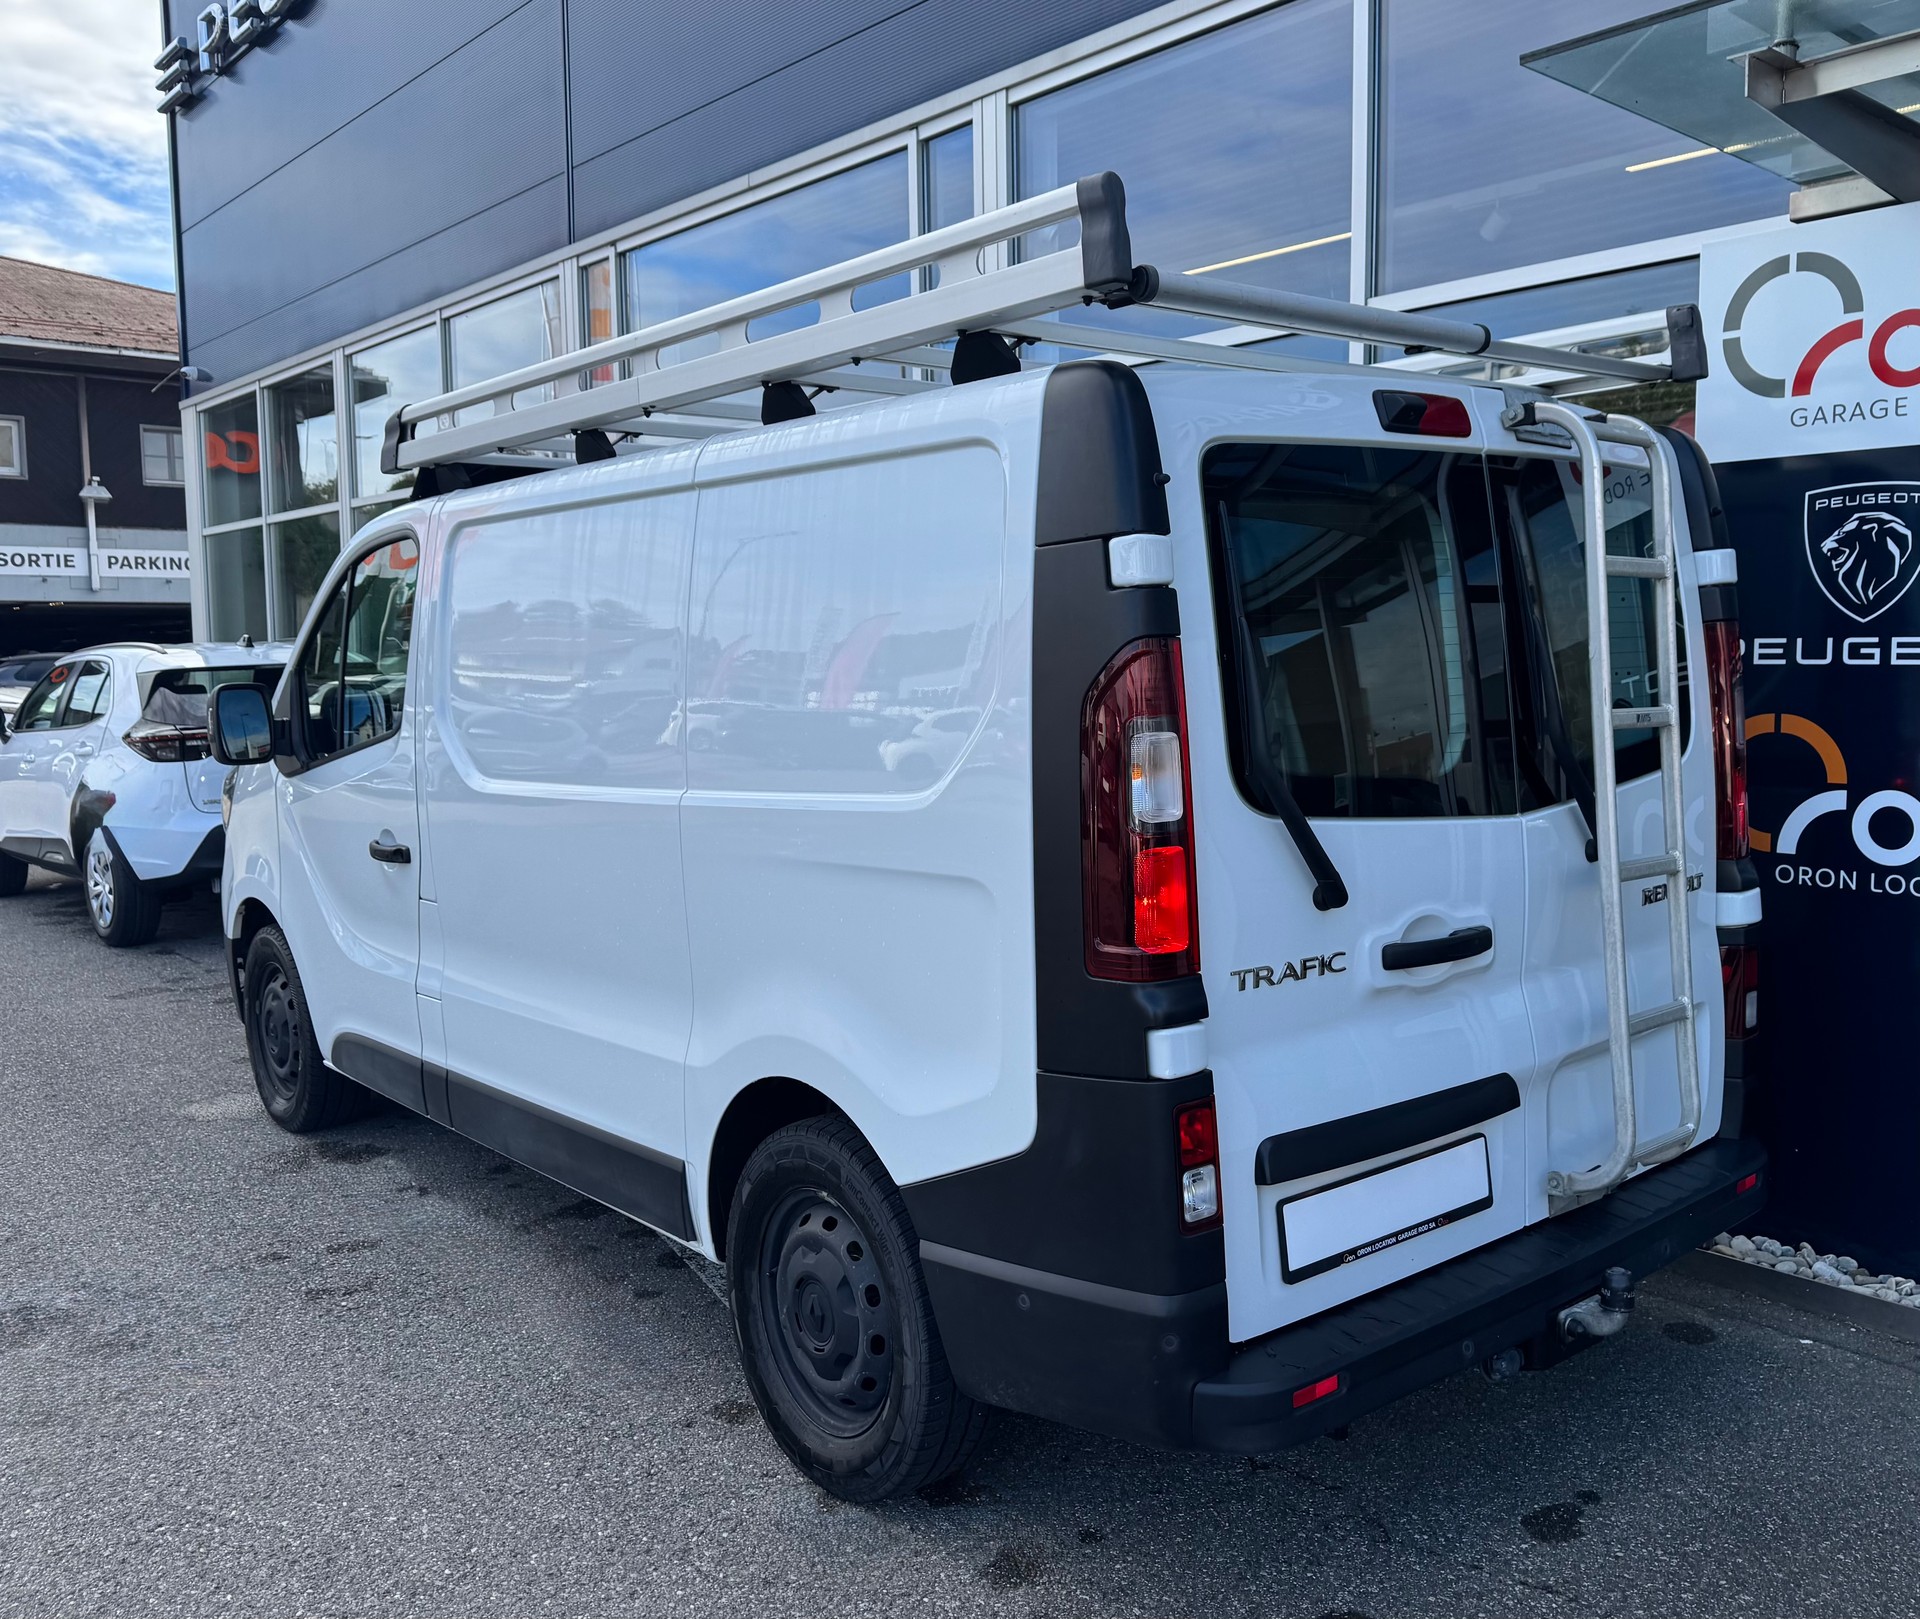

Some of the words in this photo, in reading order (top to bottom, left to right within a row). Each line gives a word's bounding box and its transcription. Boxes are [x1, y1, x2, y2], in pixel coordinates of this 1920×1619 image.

[197, 0, 292, 74] PE
[1790, 396, 1909, 428] GARAGE
[1815, 492, 1920, 511] PEUGEOT
[0, 552, 76, 568] SORTIE
[107, 555, 190, 571] PARKIN
[1739, 636, 1920, 665] EUGE
[1775, 864, 1857, 890] ORON
[1230, 951, 1347, 992] TRAFIC
[1356, 1245, 1372, 1257] ORON
[1371, 1236, 1397, 1251] LOCATION
[1397, 1227, 1418, 1241] GARAGE
[1417, 1224, 1429, 1234] ROD
[1428, 1221, 1437, 1229] SA
